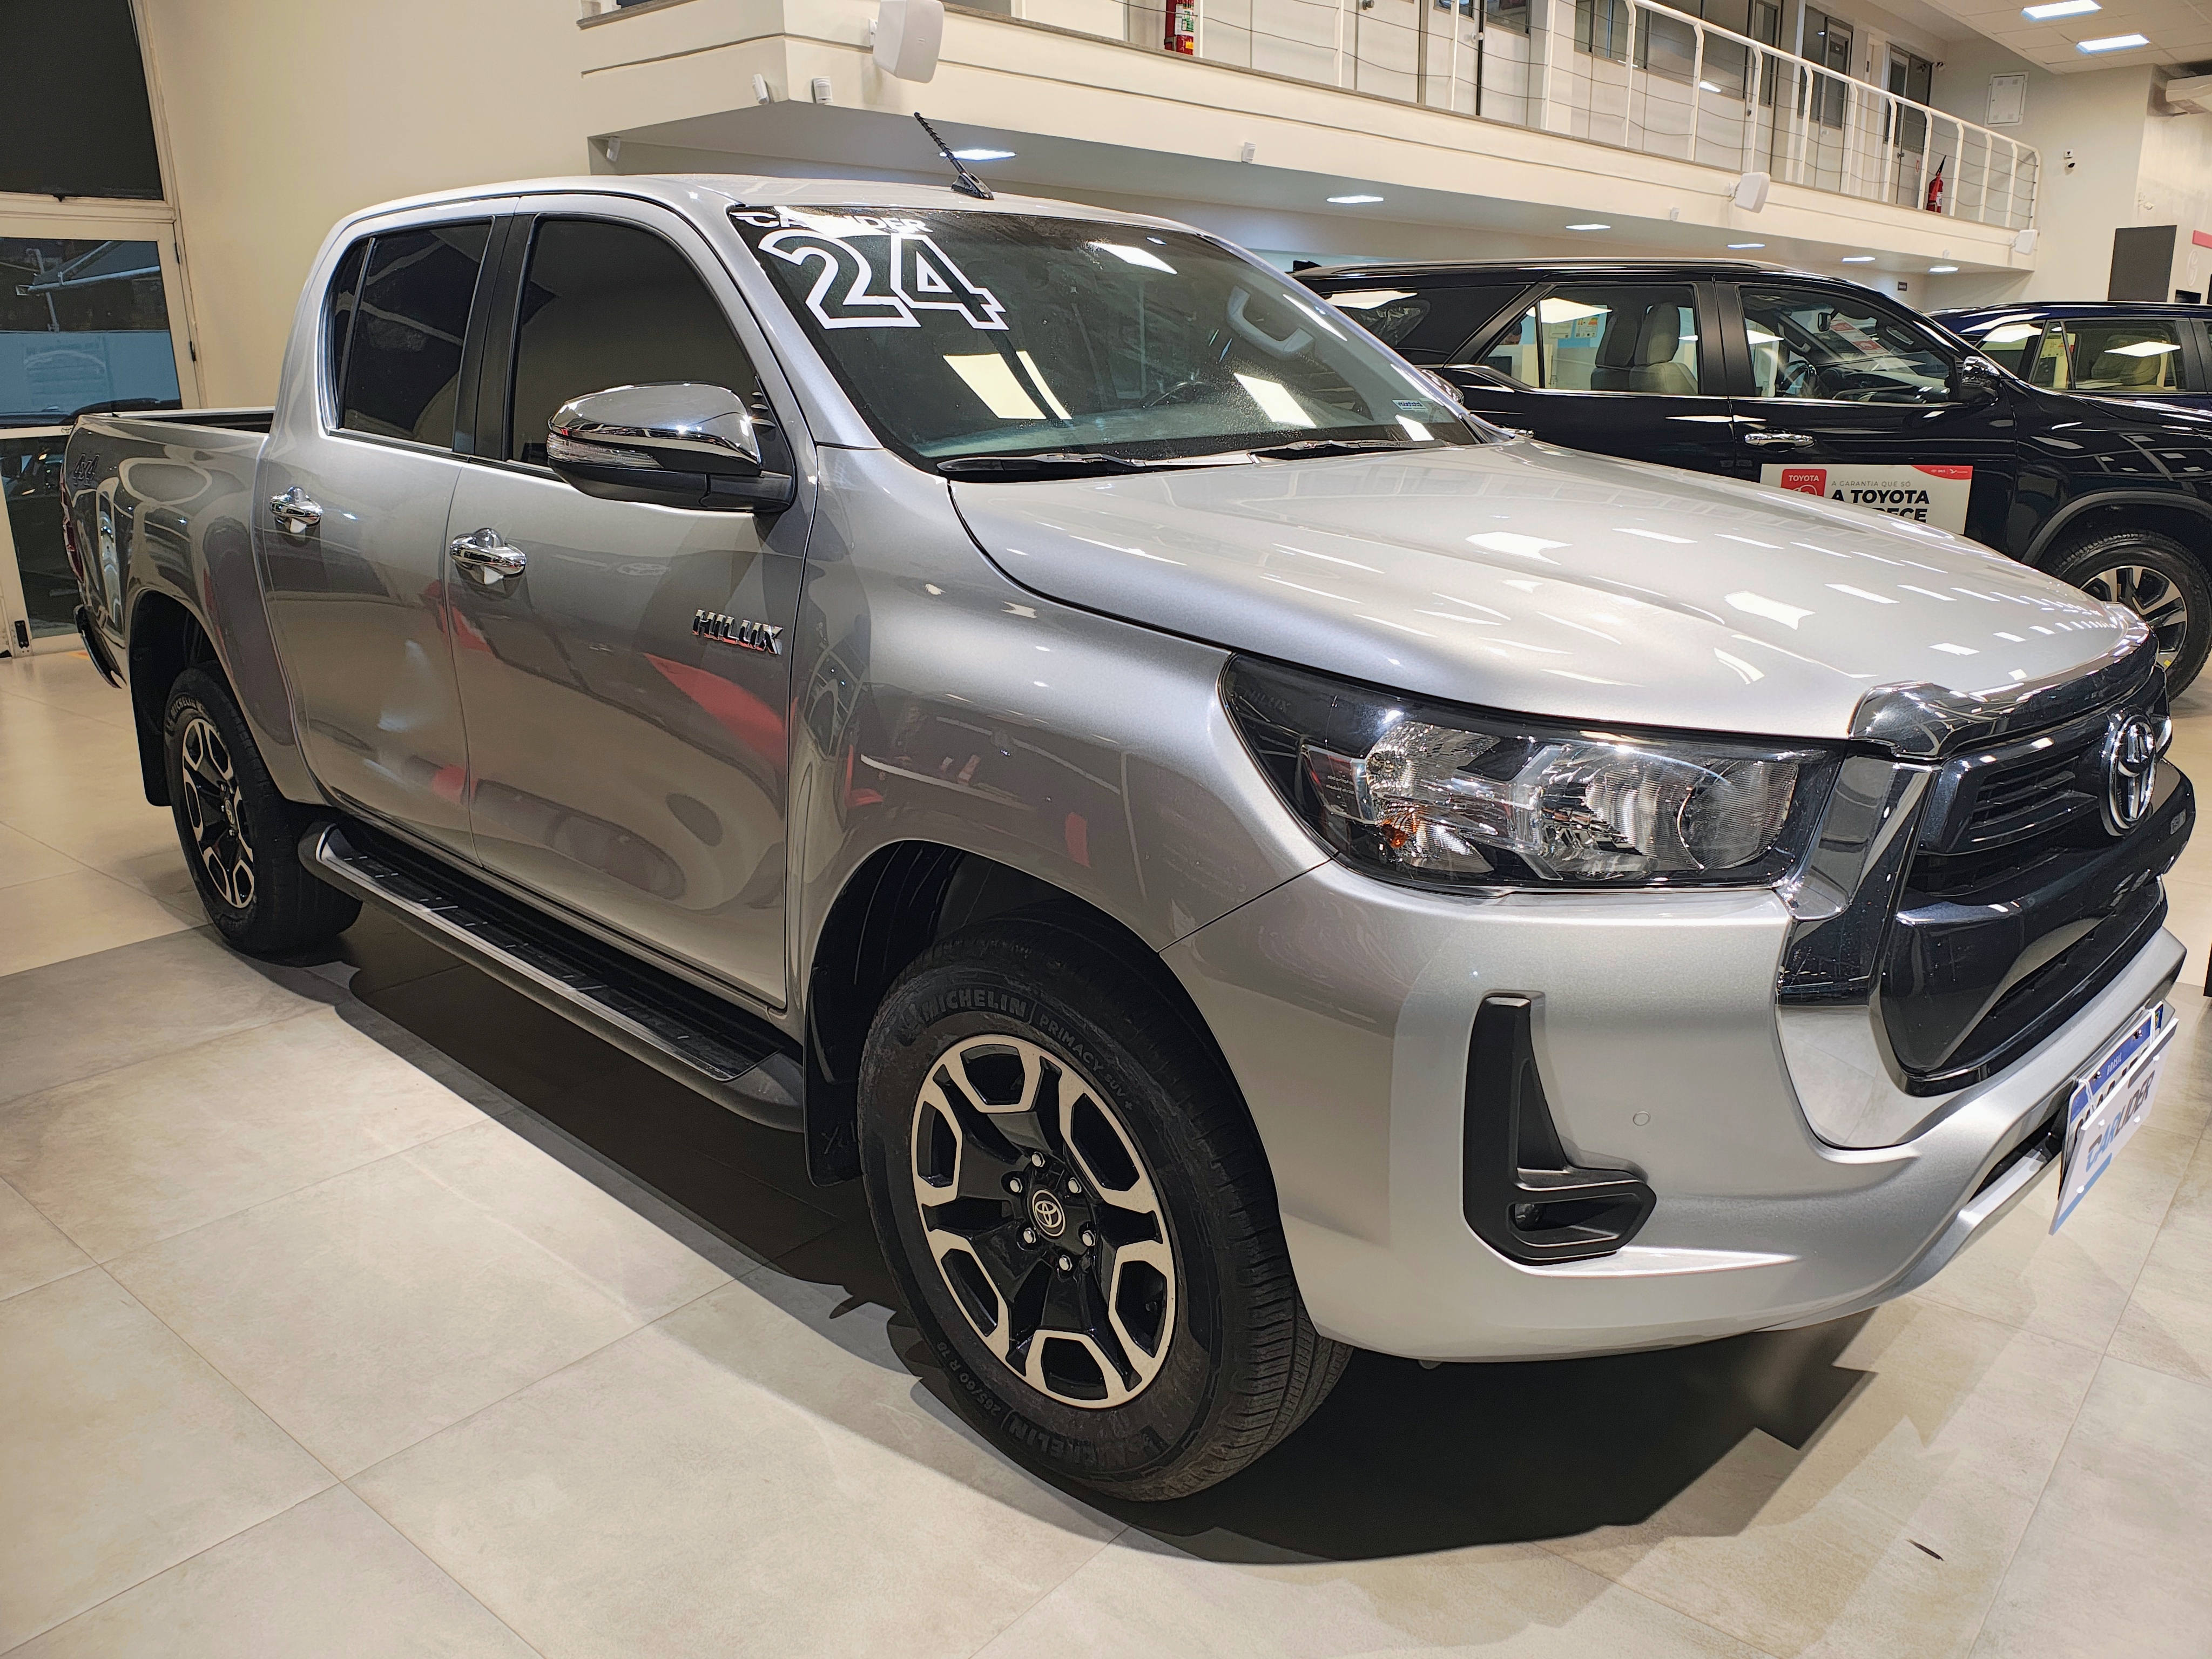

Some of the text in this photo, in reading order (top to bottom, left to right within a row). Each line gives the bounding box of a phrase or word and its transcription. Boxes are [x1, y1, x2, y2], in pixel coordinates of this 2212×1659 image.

[758, 229, 1009, 330] 24
[1831, 489, 1930, 504] A TOYOTA
[692, 609, 784, 655] HILUX
[921, 989, 1027, 1022] MICHELIN
[1039, 1014, 1104, 1071] PRIMACY
[2086, 1070, 2155, 1172] CARLIDER
[949, 1359, 961, 1371] R
